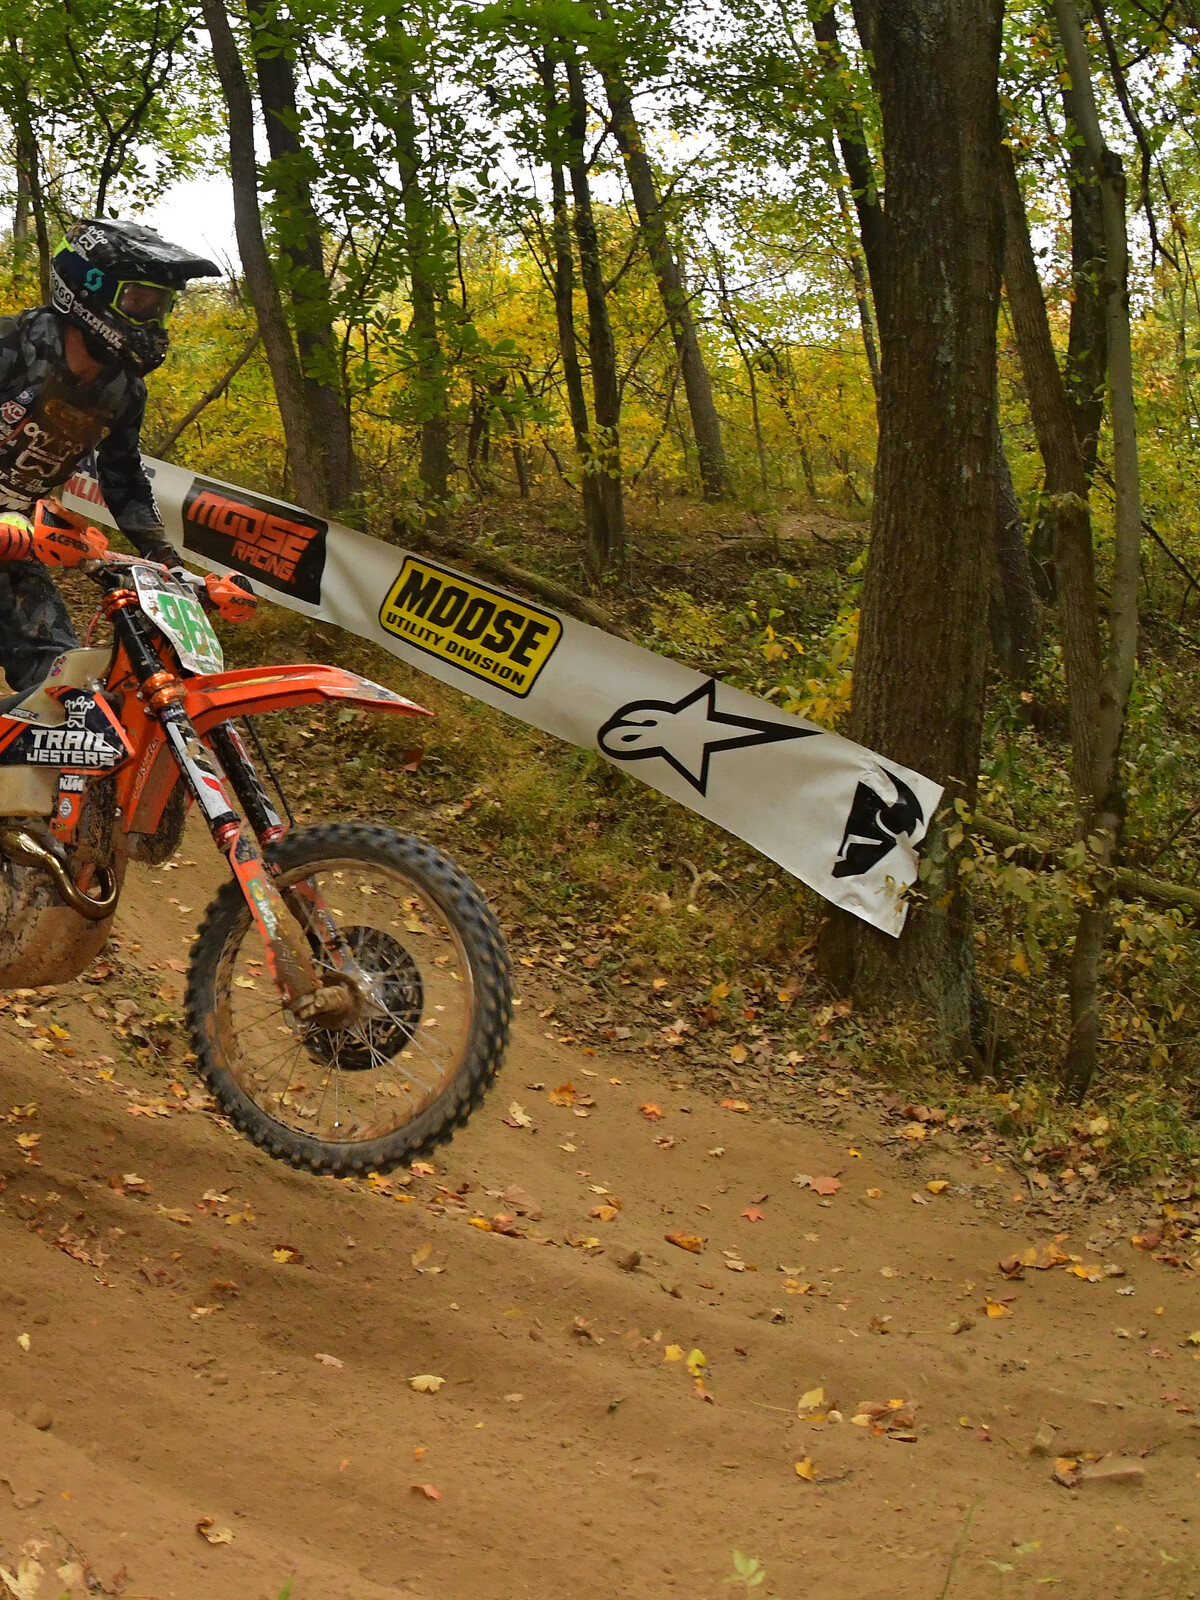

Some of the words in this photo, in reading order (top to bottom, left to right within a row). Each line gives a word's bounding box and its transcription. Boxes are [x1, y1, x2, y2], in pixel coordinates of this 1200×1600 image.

[188, 490, 319, 563] MOOSE
[397, 569, 551, 667] MOOSE
[385, 611, 443, 649] UTILITY
[442, 637, 527, 687] DIVISION
[26, 749, 116, 767] JESTERS
[31, 729, 115, 753] TRAIL
[59, 774, 84, 792] KTM
